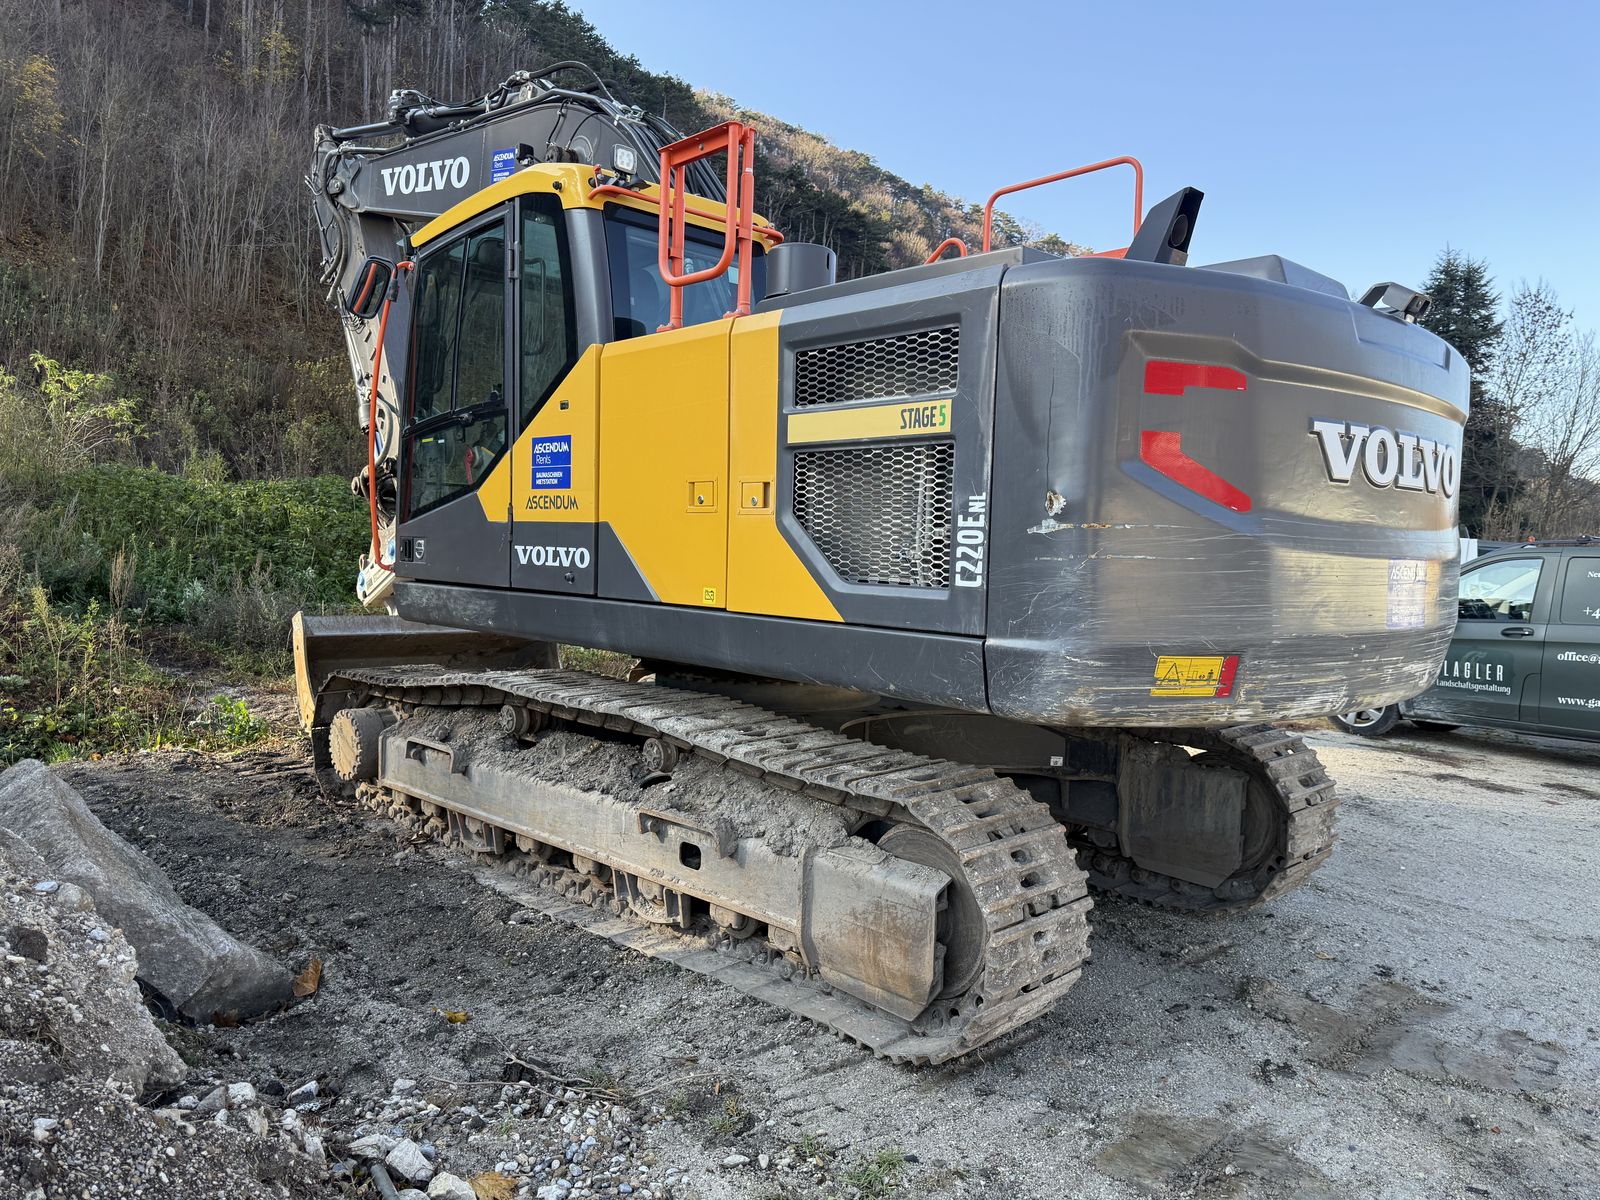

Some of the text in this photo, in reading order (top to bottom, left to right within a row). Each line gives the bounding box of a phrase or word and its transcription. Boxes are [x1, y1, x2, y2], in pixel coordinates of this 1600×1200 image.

[380, 156, 471, 196] VOLVO
[533, 441, 570, 454] ASCENDUM
[535, 454, 552, 465] Rents
[1310, 419, 1457, 498] VOLVO
[525, 495, 579, 510] ASCENDUM
[514, 545, 591, 569] VOLVO
[1443, 660, 1504, 682] LAGLER
[1436, 678, 1511, 696] Landschaftsgestaltung
